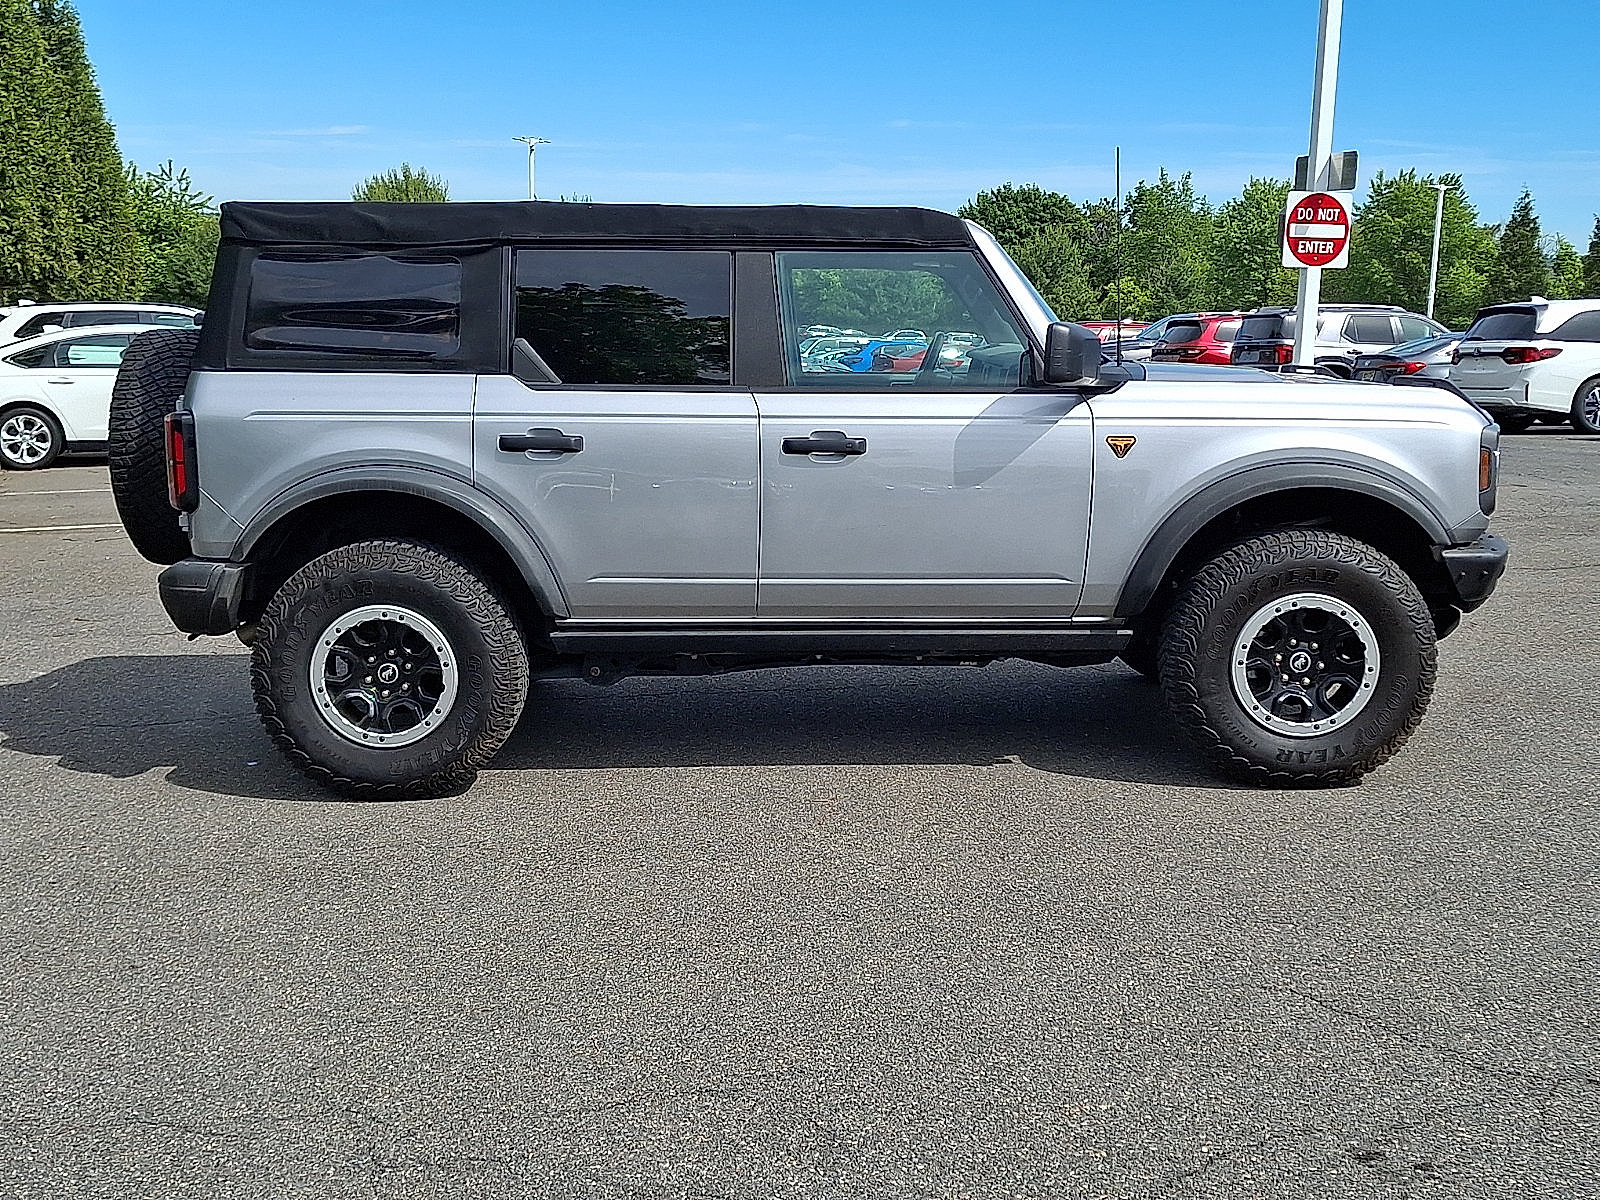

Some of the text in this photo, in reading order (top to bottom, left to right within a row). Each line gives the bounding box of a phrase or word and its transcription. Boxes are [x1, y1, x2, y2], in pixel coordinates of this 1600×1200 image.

[1297, 207, 1341, 222] DO NOT
[1297, 240, 1334, 254] ENTER
